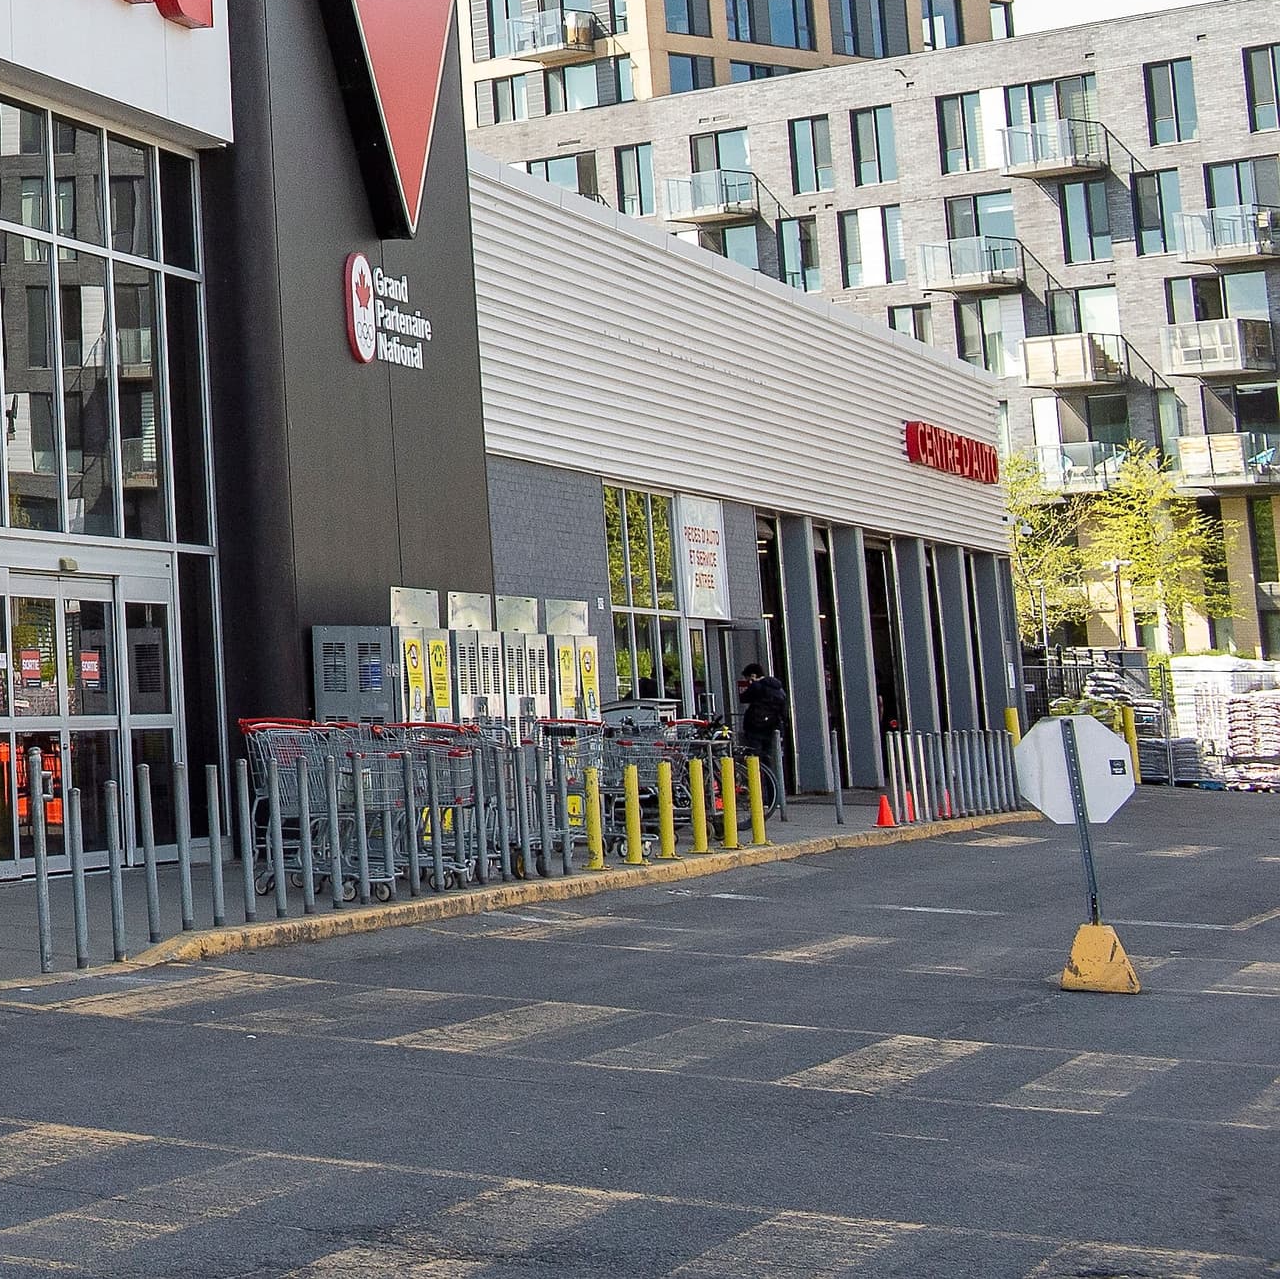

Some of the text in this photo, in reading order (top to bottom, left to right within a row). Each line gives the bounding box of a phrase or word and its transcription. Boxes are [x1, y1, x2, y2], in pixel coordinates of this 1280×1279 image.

[372, 266, 409, 303] Grand
[375, 299, 433, 341] Partenaire
[377, 331, 425, 370] National
[917, 422, 1000, 484] CENTRE D'AUTO
[696, 550, 717, 568] SERVICE
